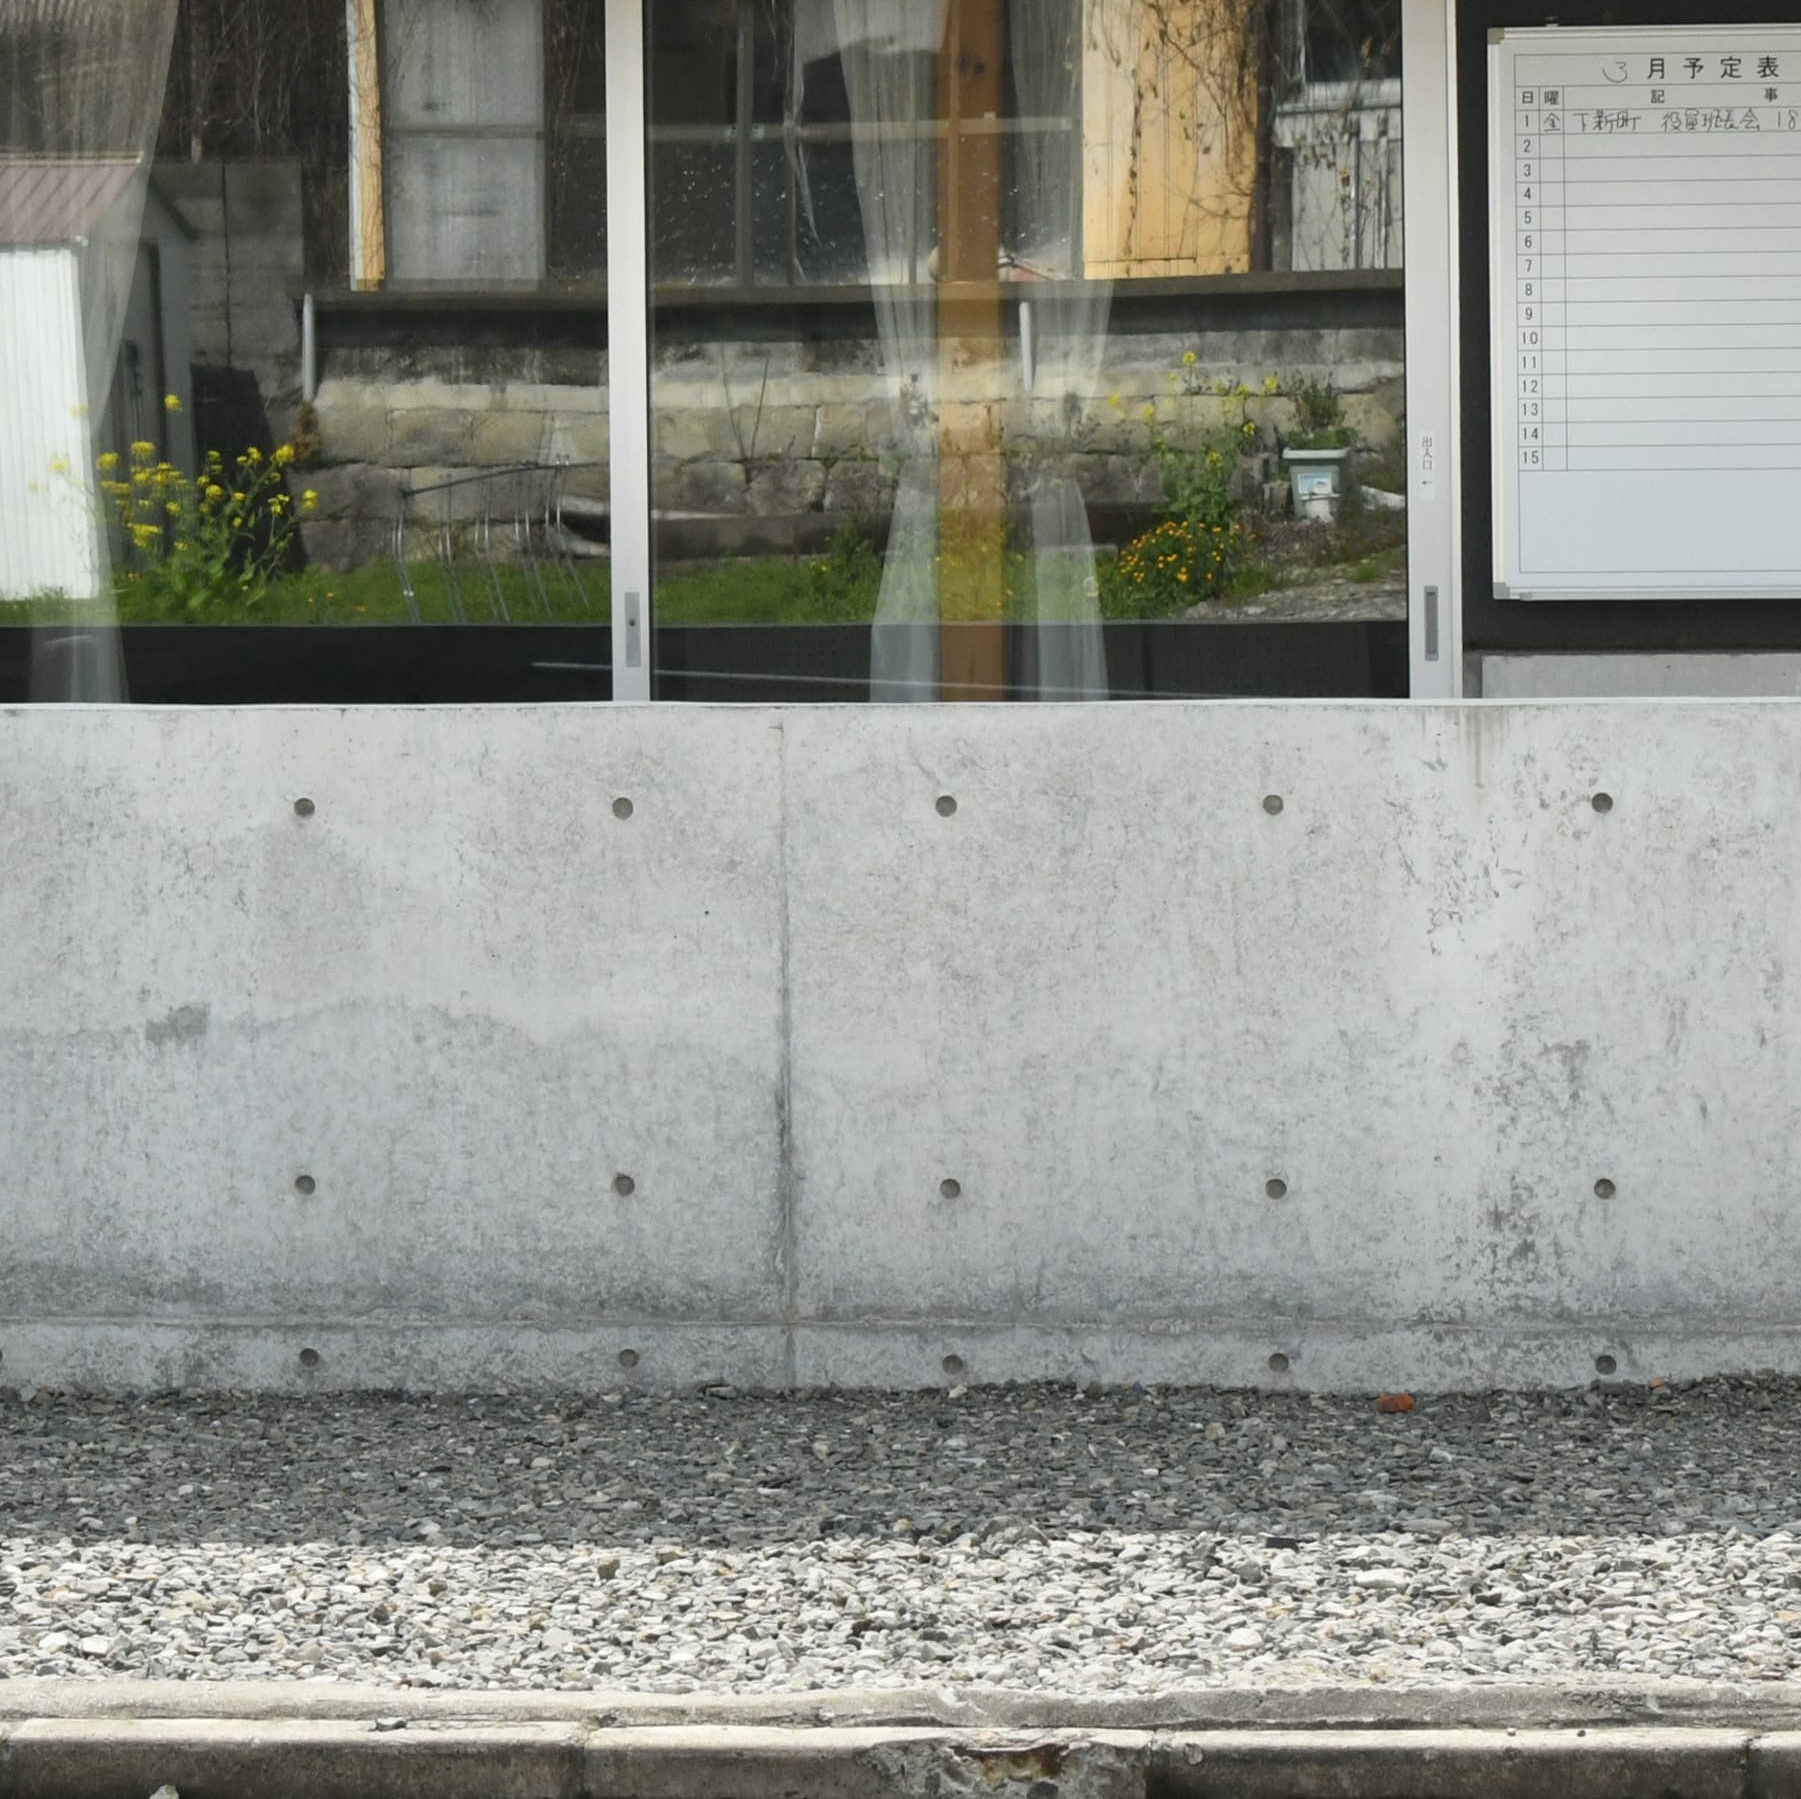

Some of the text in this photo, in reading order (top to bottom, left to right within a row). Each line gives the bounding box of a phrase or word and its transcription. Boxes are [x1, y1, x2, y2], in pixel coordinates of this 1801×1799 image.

[1524, 114, 1529, 128] 1
[1523, 138, 1532, 153] 2
[1523, 163, 1532, 178] 3
[1523, 186, 1532, 200] 4
[1524, 210, 1532, 225] 5
[1524, 234, 1533, 249] 6
[1525, 258, 1533, 273] 7
[1524, 282, 1533, 297] 8
[1524, 306, 1533, 321] 9
[1522, 330, 1539, 346] 10
[1522, 355, 1537, 370] 11
[1522, 379, 1539, 394] 12
[1522, 402, 1539, 417] 13
[1522, 426, 1539, 441] 14
[1421, 435, 1433, 471] 出入口
[1523, 450, 1540, 465] 15
